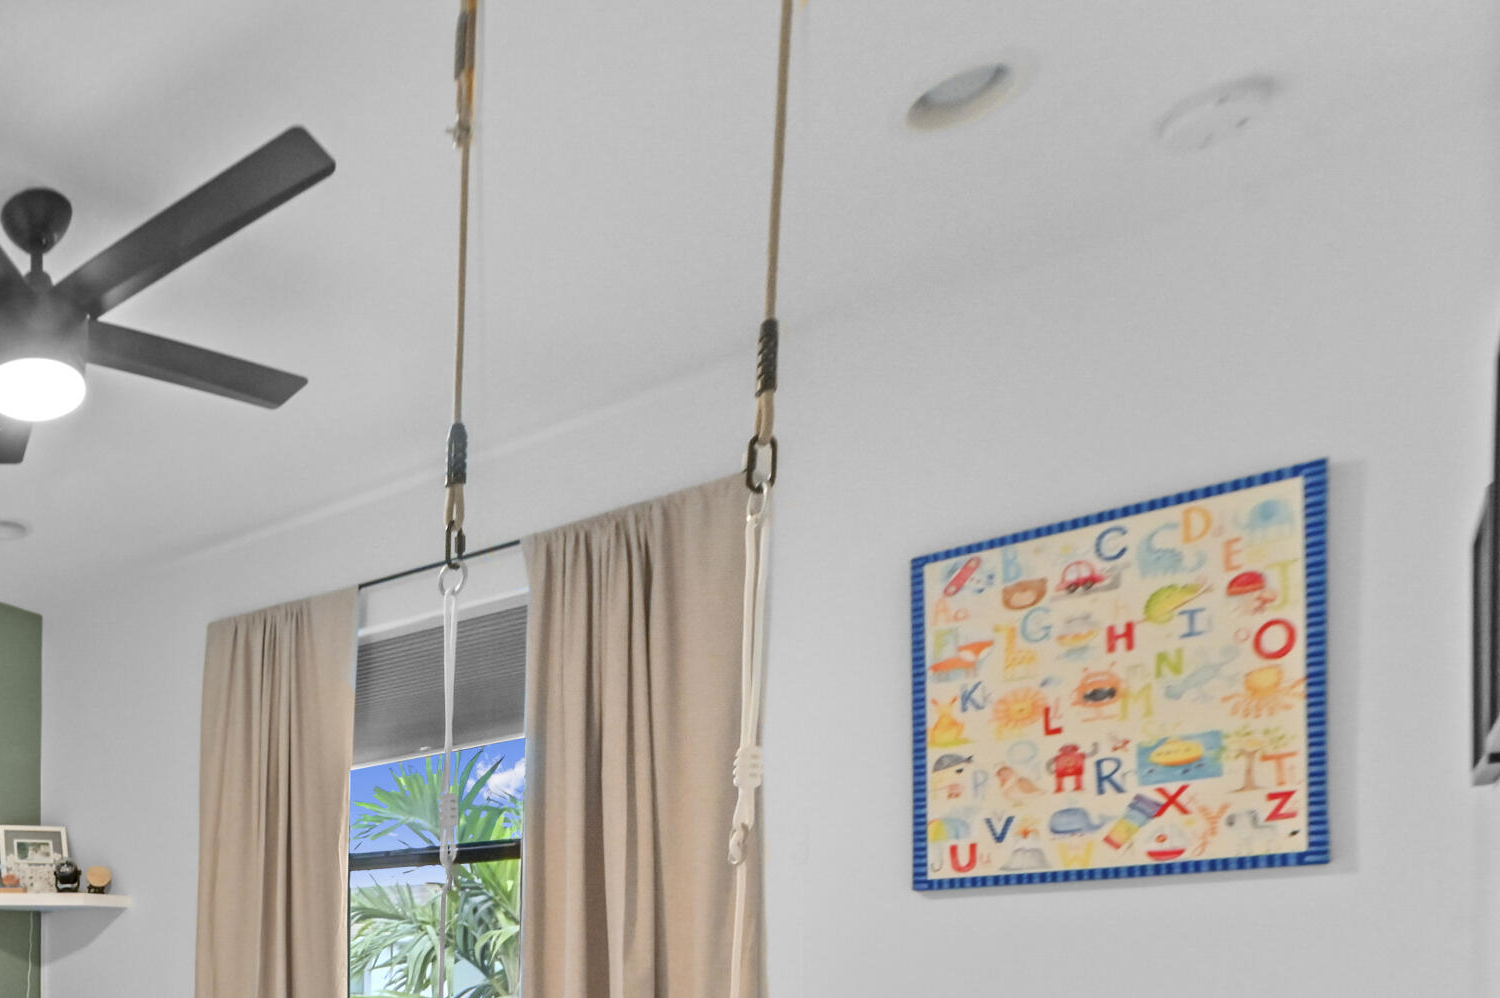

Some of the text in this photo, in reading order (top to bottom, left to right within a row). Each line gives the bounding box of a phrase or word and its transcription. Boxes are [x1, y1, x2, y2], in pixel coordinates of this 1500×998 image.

[1182, 505, 1213, 544] D
[1095, 525, 1129, 560] C
[1223, 536, 1243, 572] E
[1021, 607, 1053, 642] G
[1106, 621, 1135, 653] H
[1178, 607, 1206, 638] I
[1155, 648, 1184, 679] N
[961, 681, 986, 712] K
[1096, 757, 1126, 795] R
[1260, 752, 1298, 786] T
[1154, 784, 1191, 818] X
[1265, 790, 1298, 822] Z
[985, 815, 1015, 844] V
[949, 843, 977, 873] U
